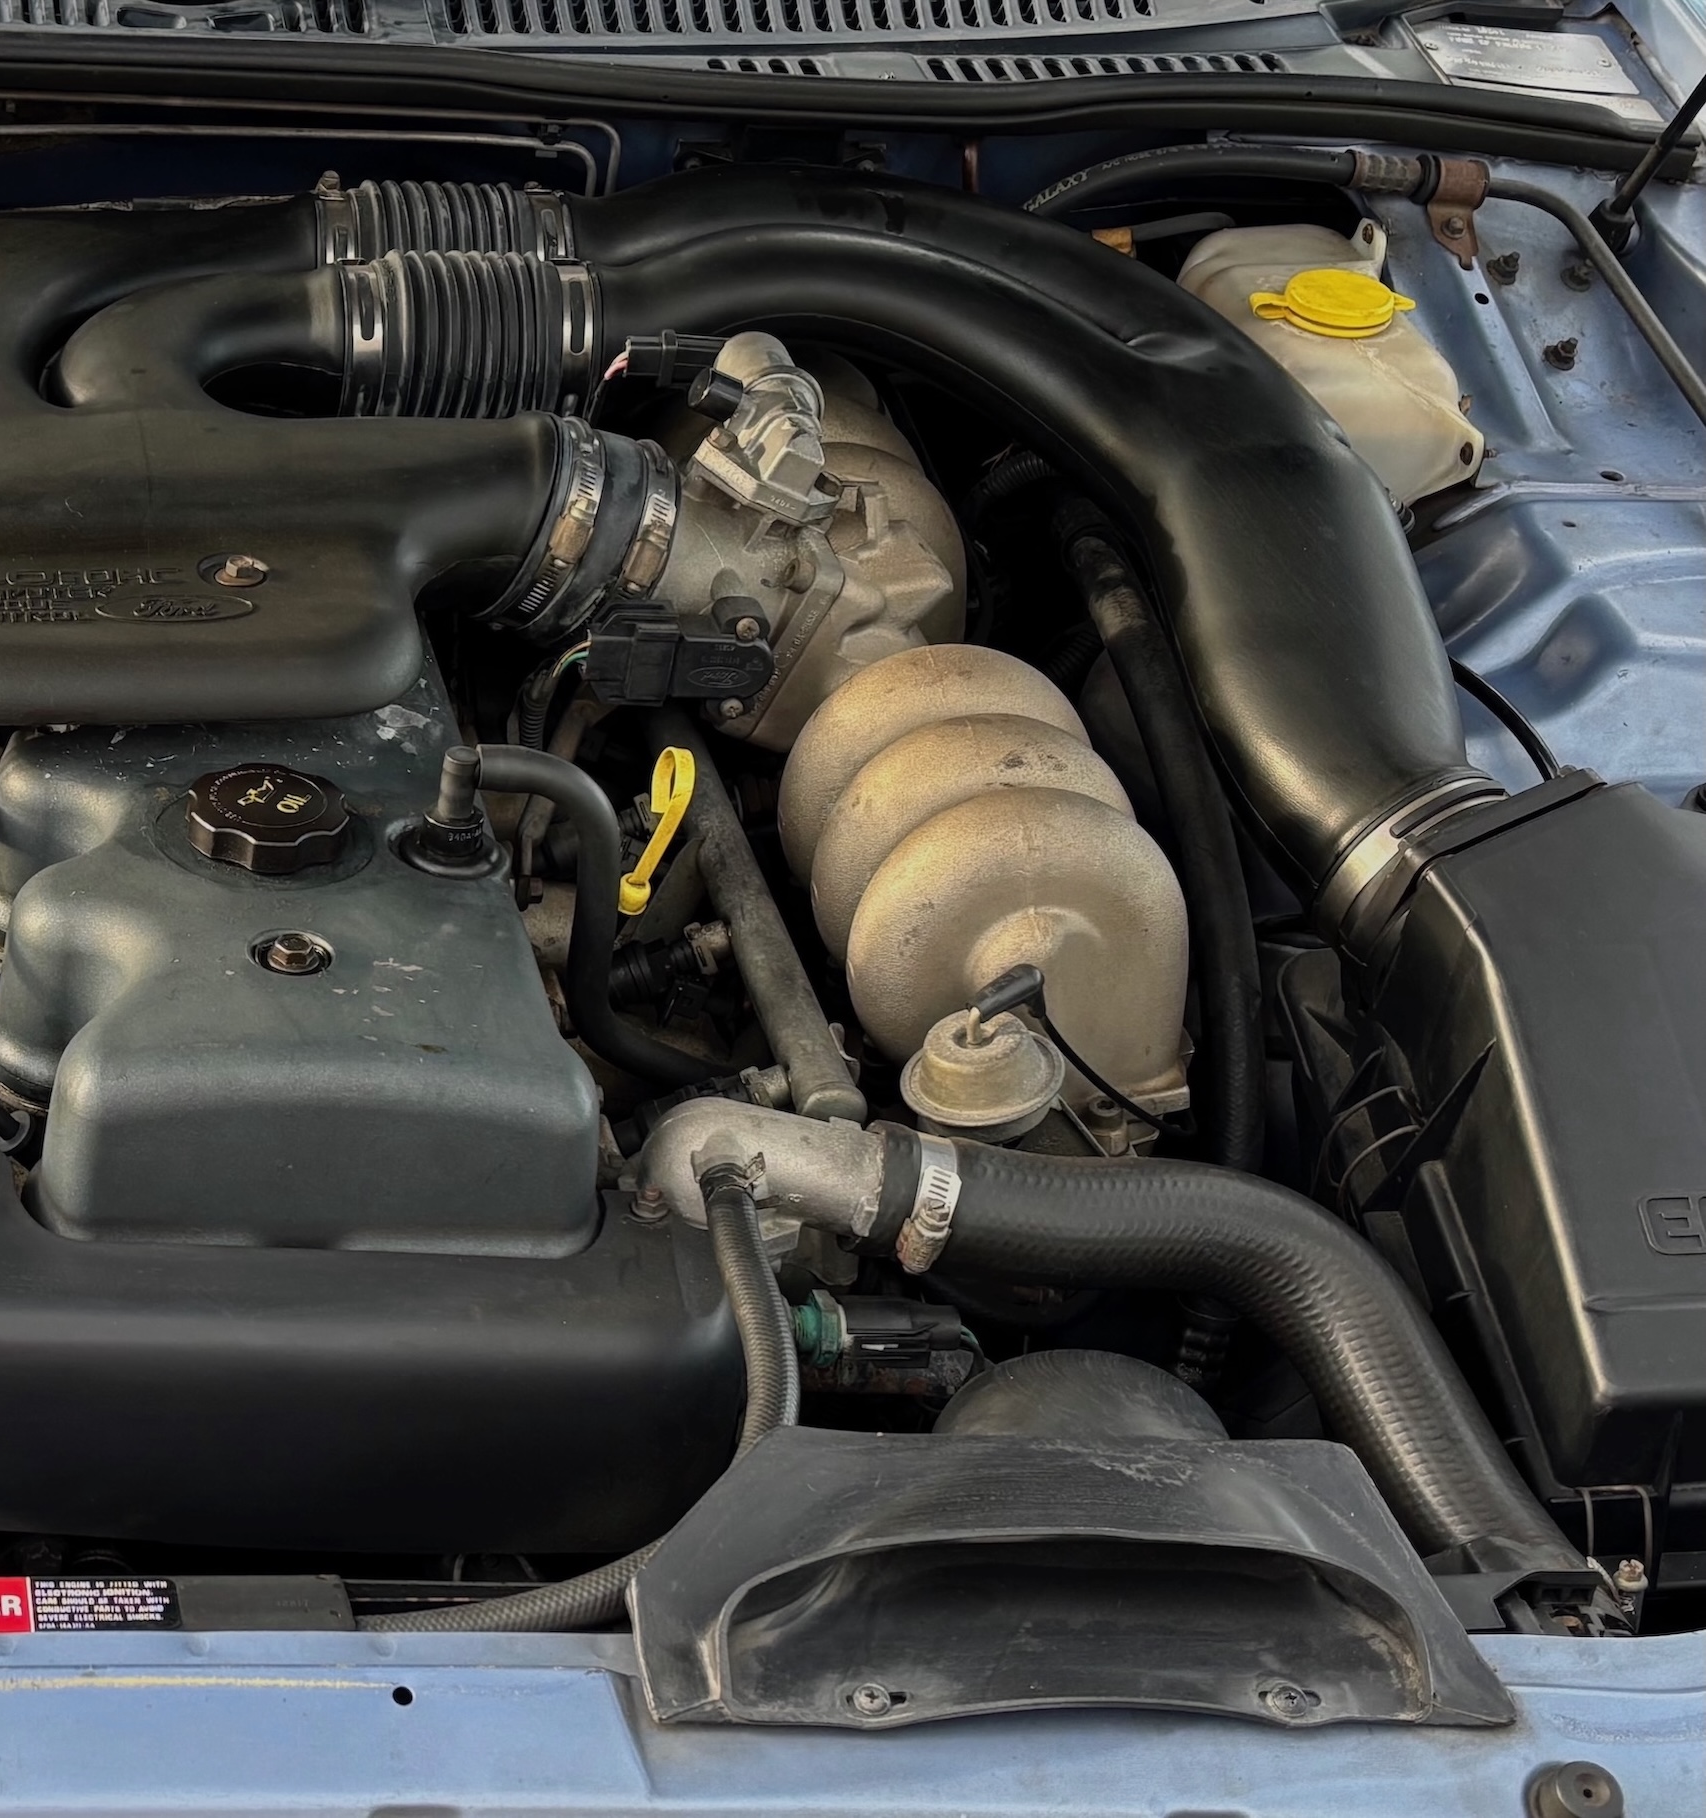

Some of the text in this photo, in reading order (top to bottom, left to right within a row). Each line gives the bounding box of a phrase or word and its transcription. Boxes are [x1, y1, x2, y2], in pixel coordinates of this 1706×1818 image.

[1023, 169, 1090, 212] GALAXY
[132, 600, 220, 617] Ford
[276, 793, 312, 813] OIL
